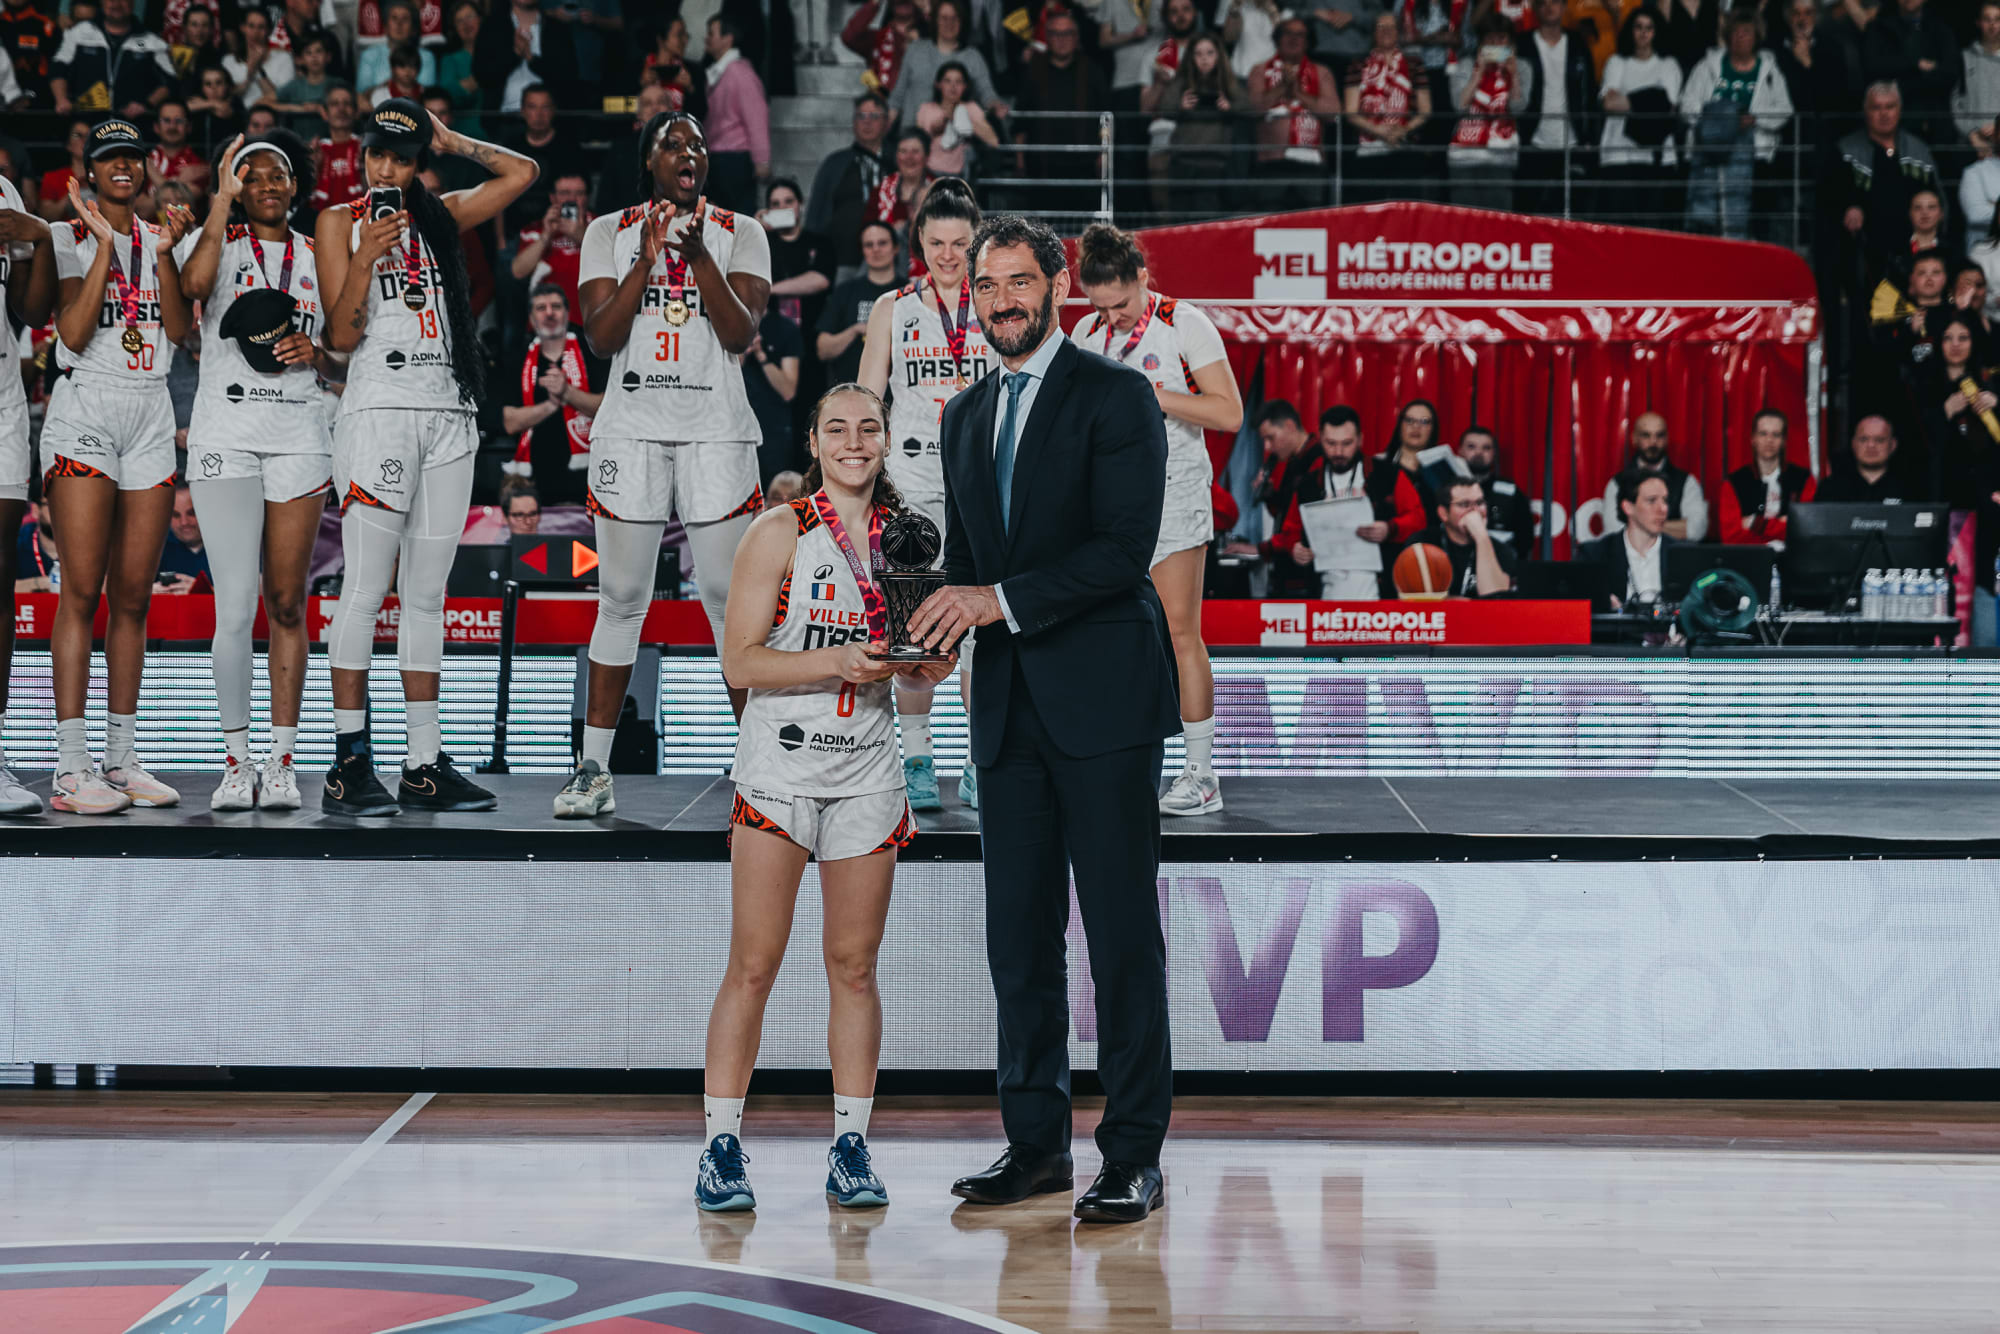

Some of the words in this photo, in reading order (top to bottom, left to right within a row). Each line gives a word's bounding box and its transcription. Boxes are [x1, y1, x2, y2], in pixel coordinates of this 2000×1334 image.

[1337, 236, 1553, 271] MÉTROPOLE
[1337, 269, 1465, 291] EUROPÉENNE
[1470, 273, 1497, 290] DE
[1501, 273, 1553, 291] LILLE
[416, 309, 438, 339] 13
[127, 343, 155, 371] 30
[411, 353, 442, 361] ADIM
[655, 331, 680, 362] 31
[645, 375, 680, 383] ADIM
[249, 388, 283, 397] ADIM
[933, 398, 946, 424] 7
[1312, 608, 1446, 630] MÉTROPOLE
[451, 630, 467, 639] DE
[470, 630, 502, 640] LILLE
[1312, 629, 1392, 642] EUROPÉENNE
[1394, 631, 1411, 641] DE
[1413, 631, 1446, 642] LILLE
[811, 733, 855, 746] ADIM
